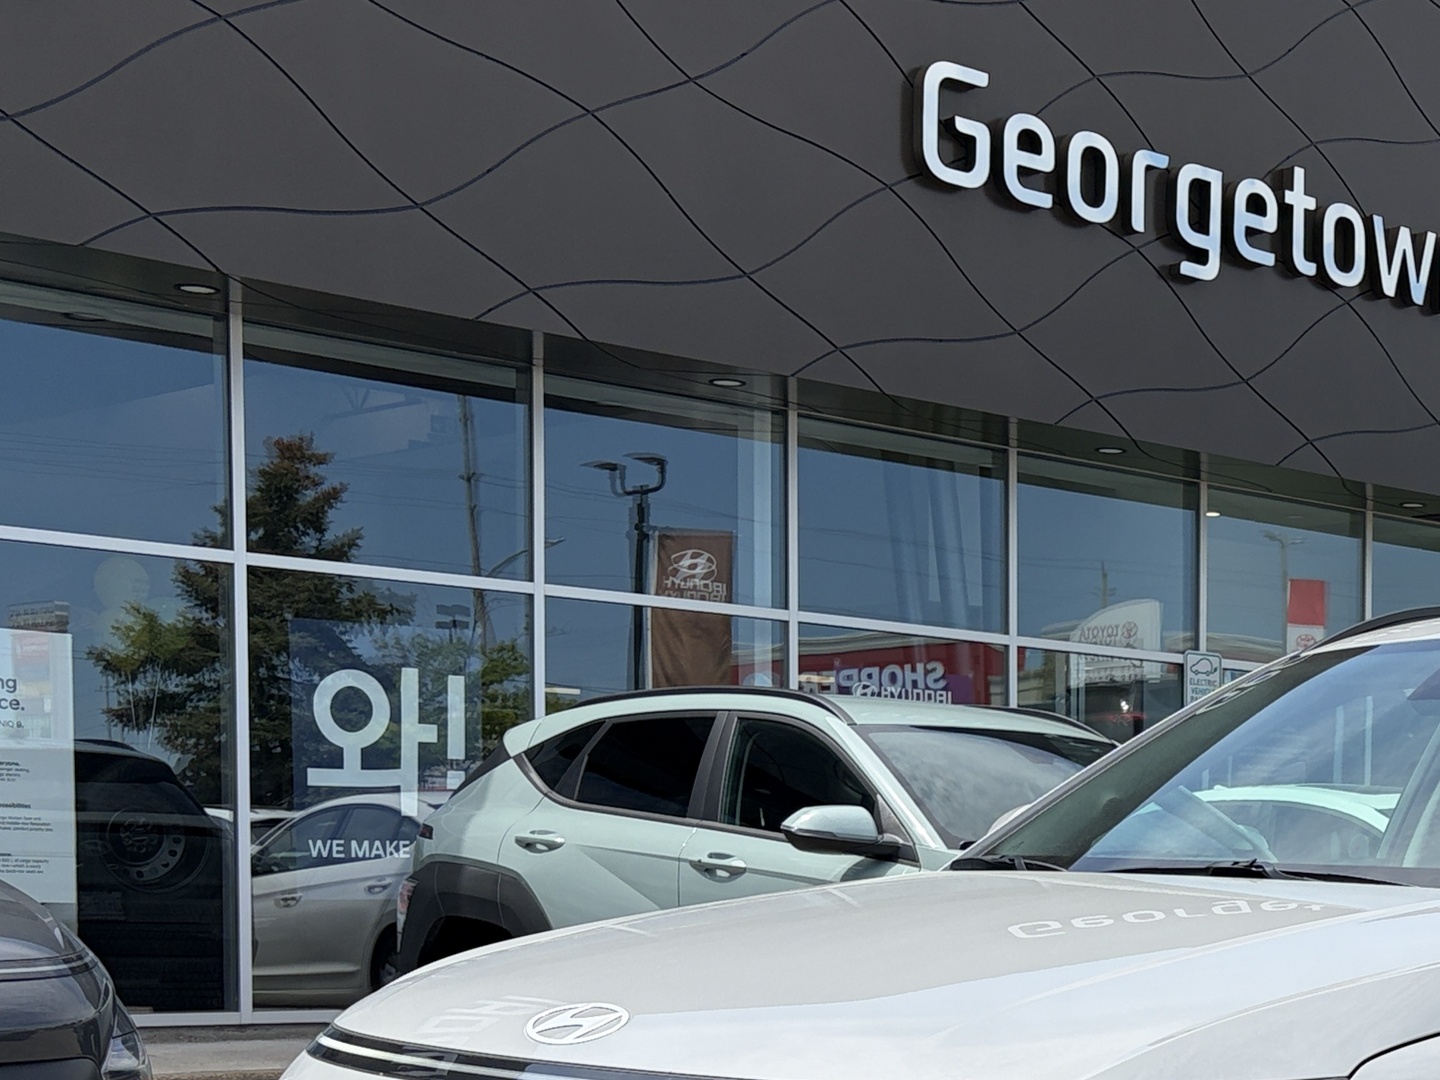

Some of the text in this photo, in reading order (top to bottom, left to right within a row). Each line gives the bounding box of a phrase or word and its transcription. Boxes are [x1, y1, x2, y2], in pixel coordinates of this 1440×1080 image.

[1189, 678, 1217, 687] ELECTRIC
[308, 839, 411, 859] WE MAKE
